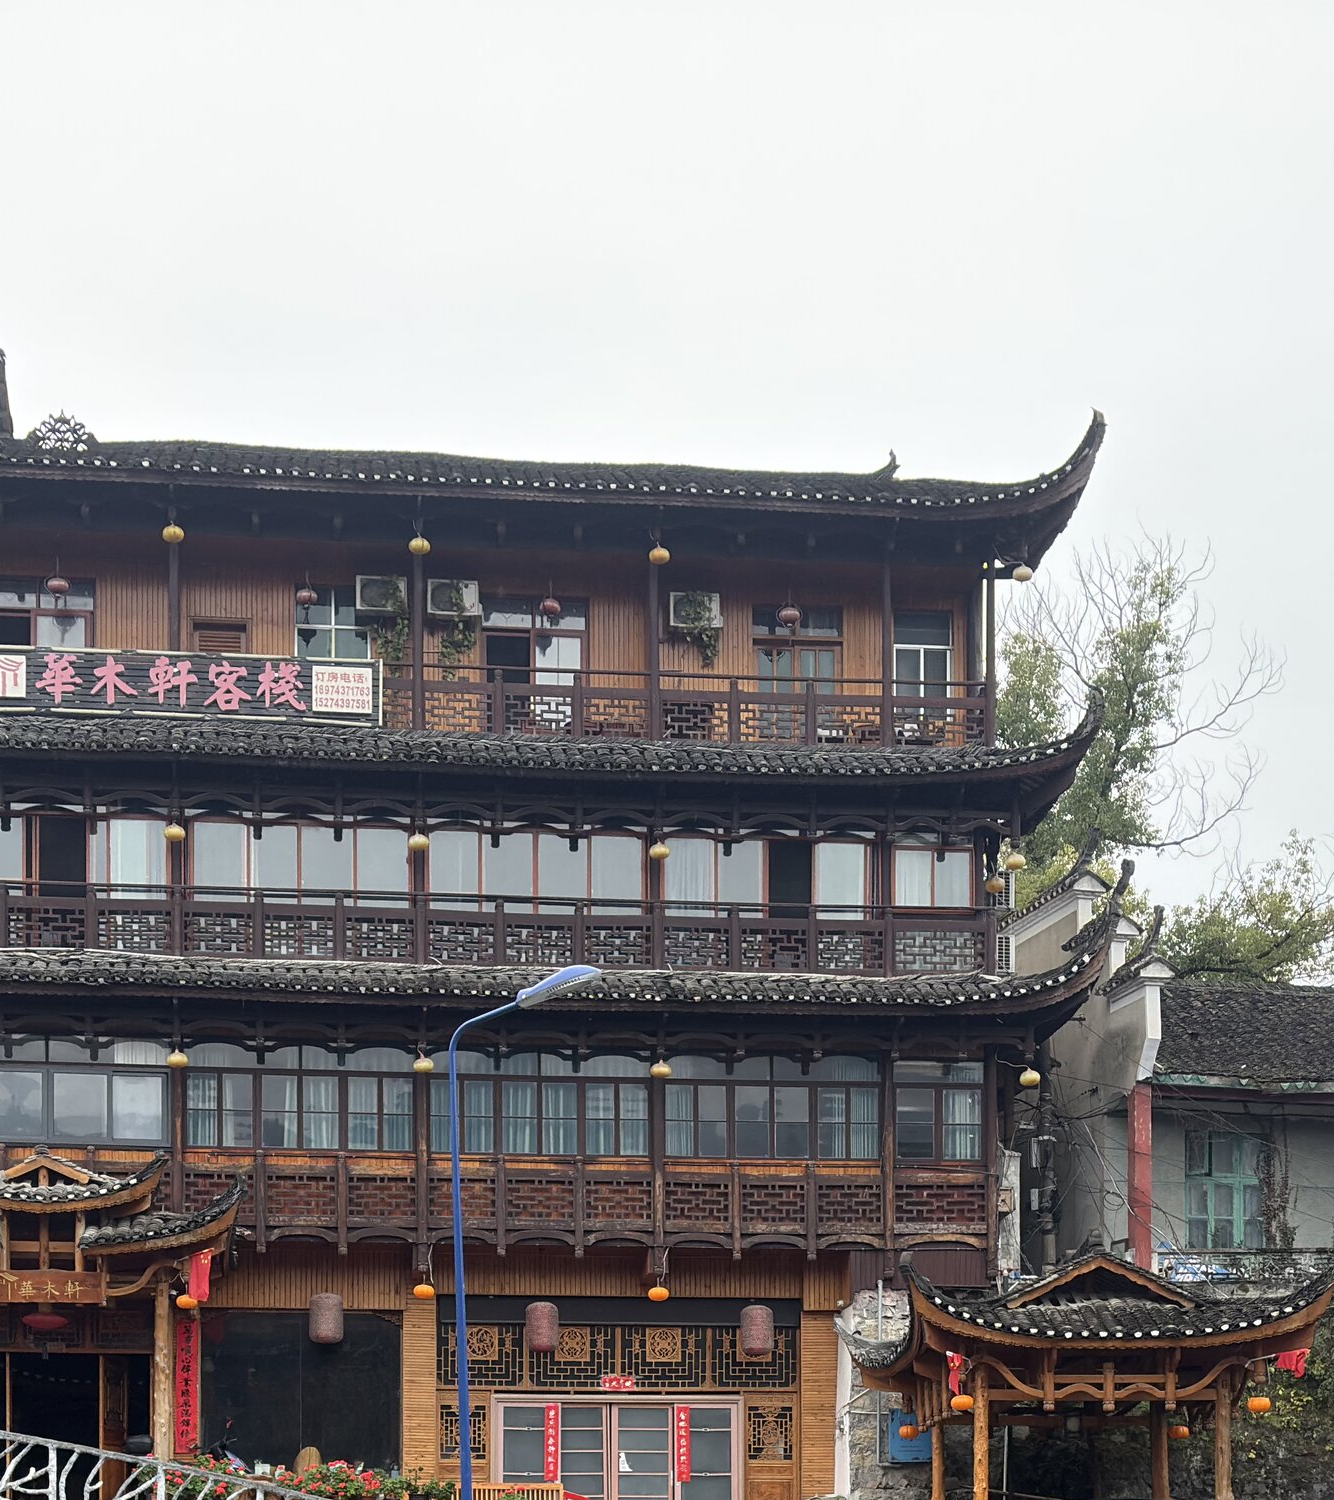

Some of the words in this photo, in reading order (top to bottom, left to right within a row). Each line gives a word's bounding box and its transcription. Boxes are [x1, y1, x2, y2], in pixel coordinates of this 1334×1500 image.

[35, 654, 307, 711] 華木軒客棧
[18, 1280, 83, 1299] 華木軒
